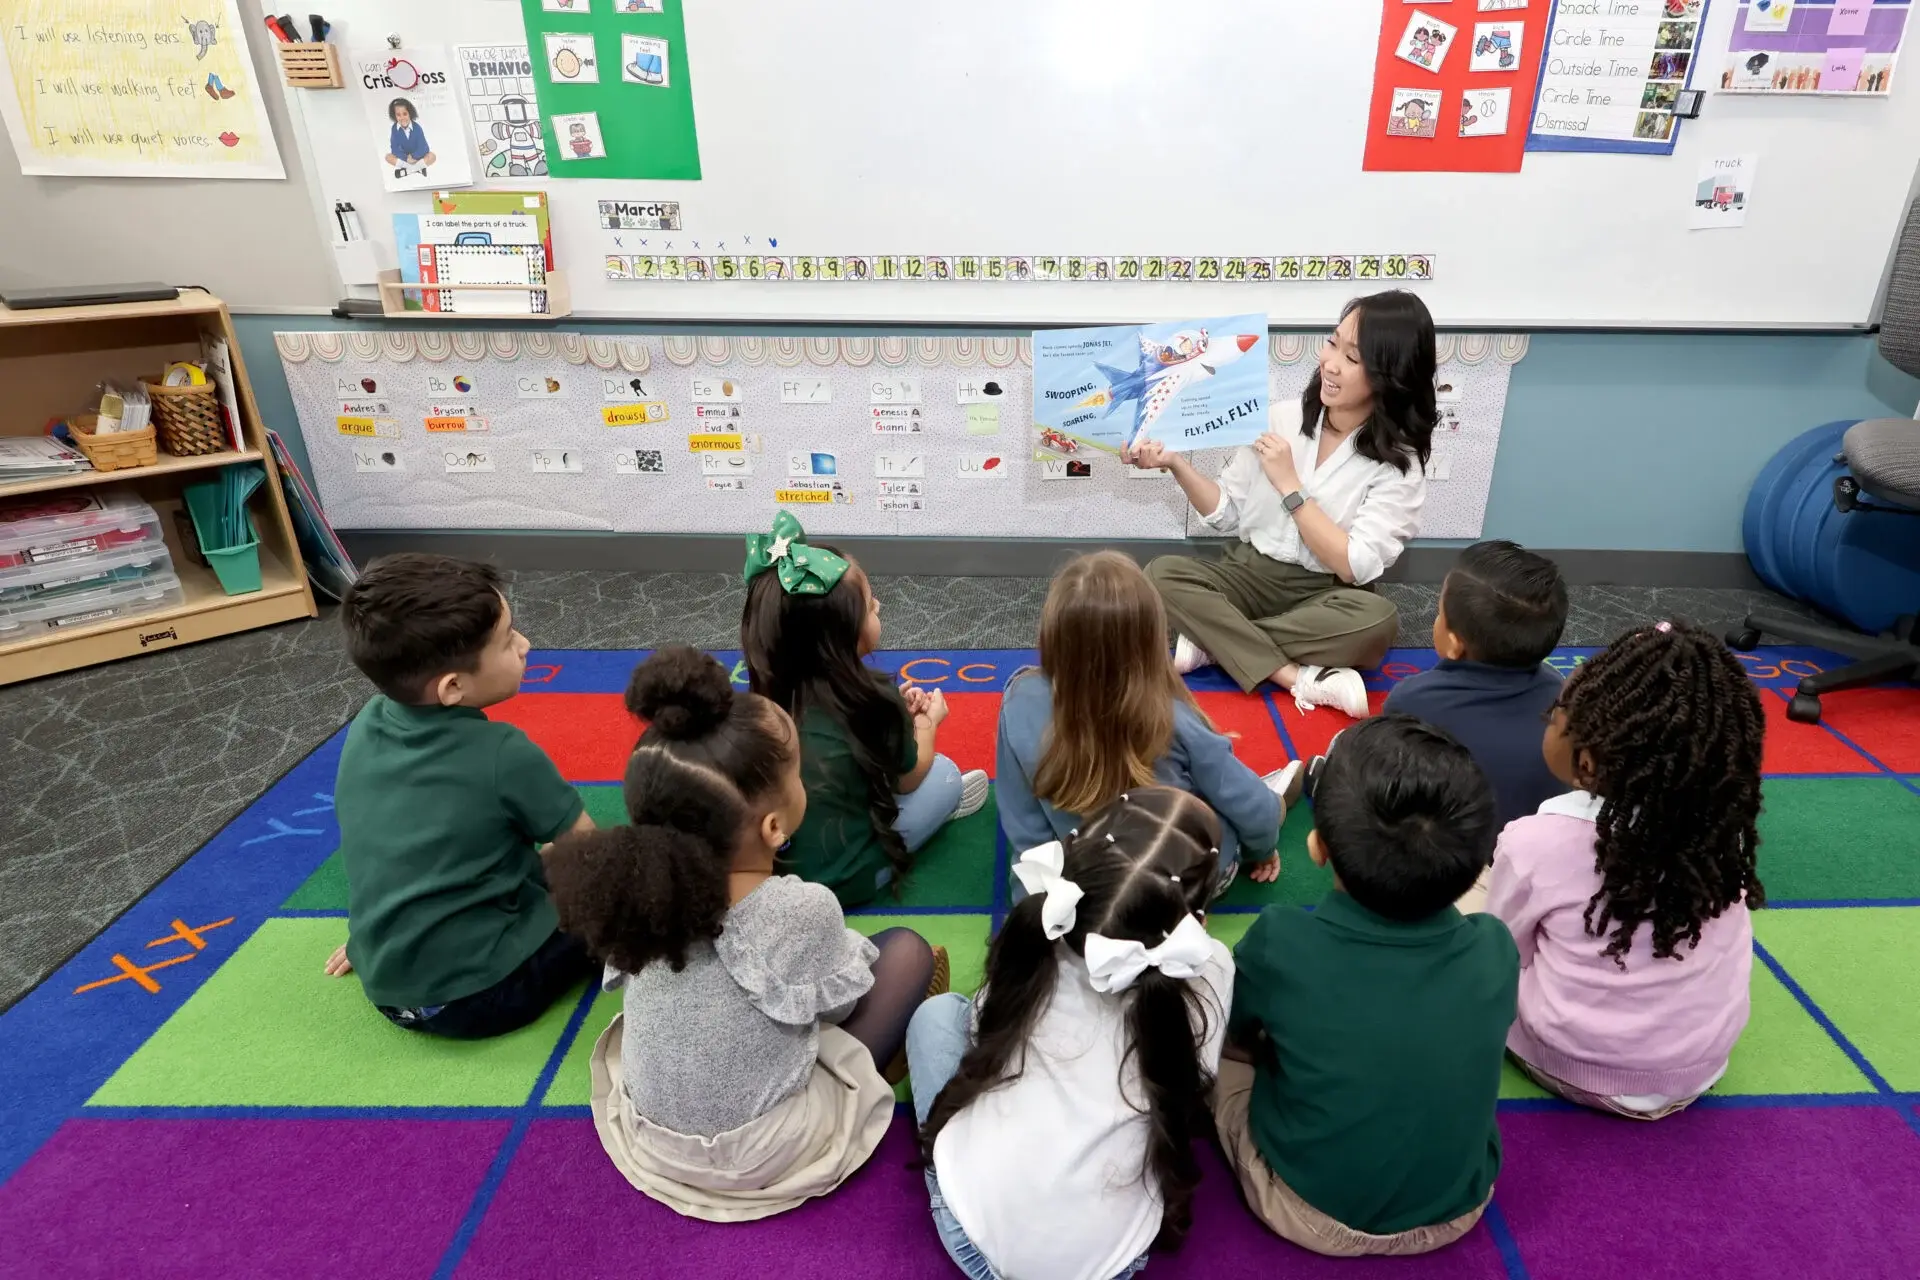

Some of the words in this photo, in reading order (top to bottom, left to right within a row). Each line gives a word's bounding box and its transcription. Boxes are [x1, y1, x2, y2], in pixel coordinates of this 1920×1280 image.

[1558, 0, 1600, 15] Snack
[1607, 0, 1639, 15] Time
[15, 26, 28, 40] I
[36, 28, 56, 43] will
[62, 31, 81, 43] use
[87, 24, 148, 50] listening
[1553, 28, 1592, 46] Circle
[1599, 29, 1625, 46] Time
[469, 61, 532, 77] BEHAVIO
[1548, 58, 1602, 77] Outside
[1608, 59, 1639, 77] Time
[36, 79, 48, 95] I
[53, 77, 77, 97] will
[83, 85, 102, 97] use
[110, 81, 161, 101] walking
[167, 78, 197, 99] feet
[363, 74, 398, 90] Cris
[1541, 87, 1579, 105] Circle
[1586, 88, 1611, 106] Time
[1535, 112, 1590, 132] Dismissal
[43, 126, 58, 145] I
[71, 128, 94, 145] will
[103, 133, 124, 145] use
[131, 131, 163, 154] quiet
[1714, 158, 1743, 168] truck
[615, 203, 664, 217] March
[444, 220, 460, 228] label
[461, 220, 472, 228] the
[473, 220, 492, 231] parts
[493, 220, 500, 228] of
[644, 260, 654, 276] 2
[670, 260, 679, 275] 3
[696, 260, 706, 277] 4
[723, 260, 733, 277] 5
[749, 260, 759, 277] 6
[775, 262, 784, 278] 7
[803, 261, 811, 277] 8
[828, 261, 838, 277] 9
[854, 260, 866, 277] 10
[883, 259, 892, 277] 11
[907, 259, 922, 277] 12
[935, 261, 948, 278] 13
[962, 260, 975, 277] 14
[989, 261, 1001, 277] 15
[1016, 261, 1028, 277] 16
[1043, 260, 1056, 275] 17
[1069, 260, 1081, 278] 18
[1096, 262, 1108, 278] 19
[1119, 260, 1138, 278] 20
[1149, 260, 1162, 277] 21
[1172, 261, 1192, 278] 22
[1199, 260, 1219, 278] 23
[1225, 260, 1246, 278] 24
[1252, 262, 1271, 278] 25
[1281, 261, 1298, 278] 26
[1307, 260, 1325, 277] 27
[1334, 260, 1351, 277] 28
[1360, 259, 1380, 277] 29
[1386, 258, 1406, 276] 30
[1416, 260, 1429, 277] 31
[1082, 341, 1102, 349] JONAS
[338, 378, 358, 392] Aa
[428, 376, 447, 392] Bb
[518, 377, 539, 393] Cc
[604, 379, 625, 394] Dd
[693, 381, 712, 396] Ee
[783, 381, 800, 396] Ff
[871, 382, 892, 400] Gg
[958, 382, 978, 397] Hh
[1045, 382, 1097, 400] SWOOPING,
[343, 403, 376, 413] Andres
[433, 406, 465, 416] Bryson
[696, 406, 726, 417] Emma
[873, 408, 908, 417] Genesis
[427, 418, 465, 429] burrow
[607, 410, 646, 424] drowsy
[1062, 412, 1097, 428] SOARING,
[1184, 425, 1204, 437] FLY,
[1205, 415, 1229, 433] FLY,
[1228, 398, 1260, 421] FLY!
[341, 423, 373, 434] argue
[704, 422, 722, 433] Eva
[875, 421, 907, 432] Gianni
[690, 440, 741, 450] enormous
[354, 453, 376, 466] Nn
[444, 452, 467, 466] Oo
[534, 452, 551, 470] Pp
[616, 453, 638, 471] Qq
[704, 454, 721, 469] Rr
[791, 456, 807, 471] Ss
[880, 456, 894, 471] Tt
[959, 457, 979, 472] Uu
[1046, 459, 1063, 473] Vv
[787, 480, 830, 489] Sebastian
[880, 482, 906, 494] Tyler
[779, 490, 830, 501] stretched
[878, 499, 909, 510] Tyshon
[520, 664, 563, 684] a
[72, 916, 236, 995] Xx
